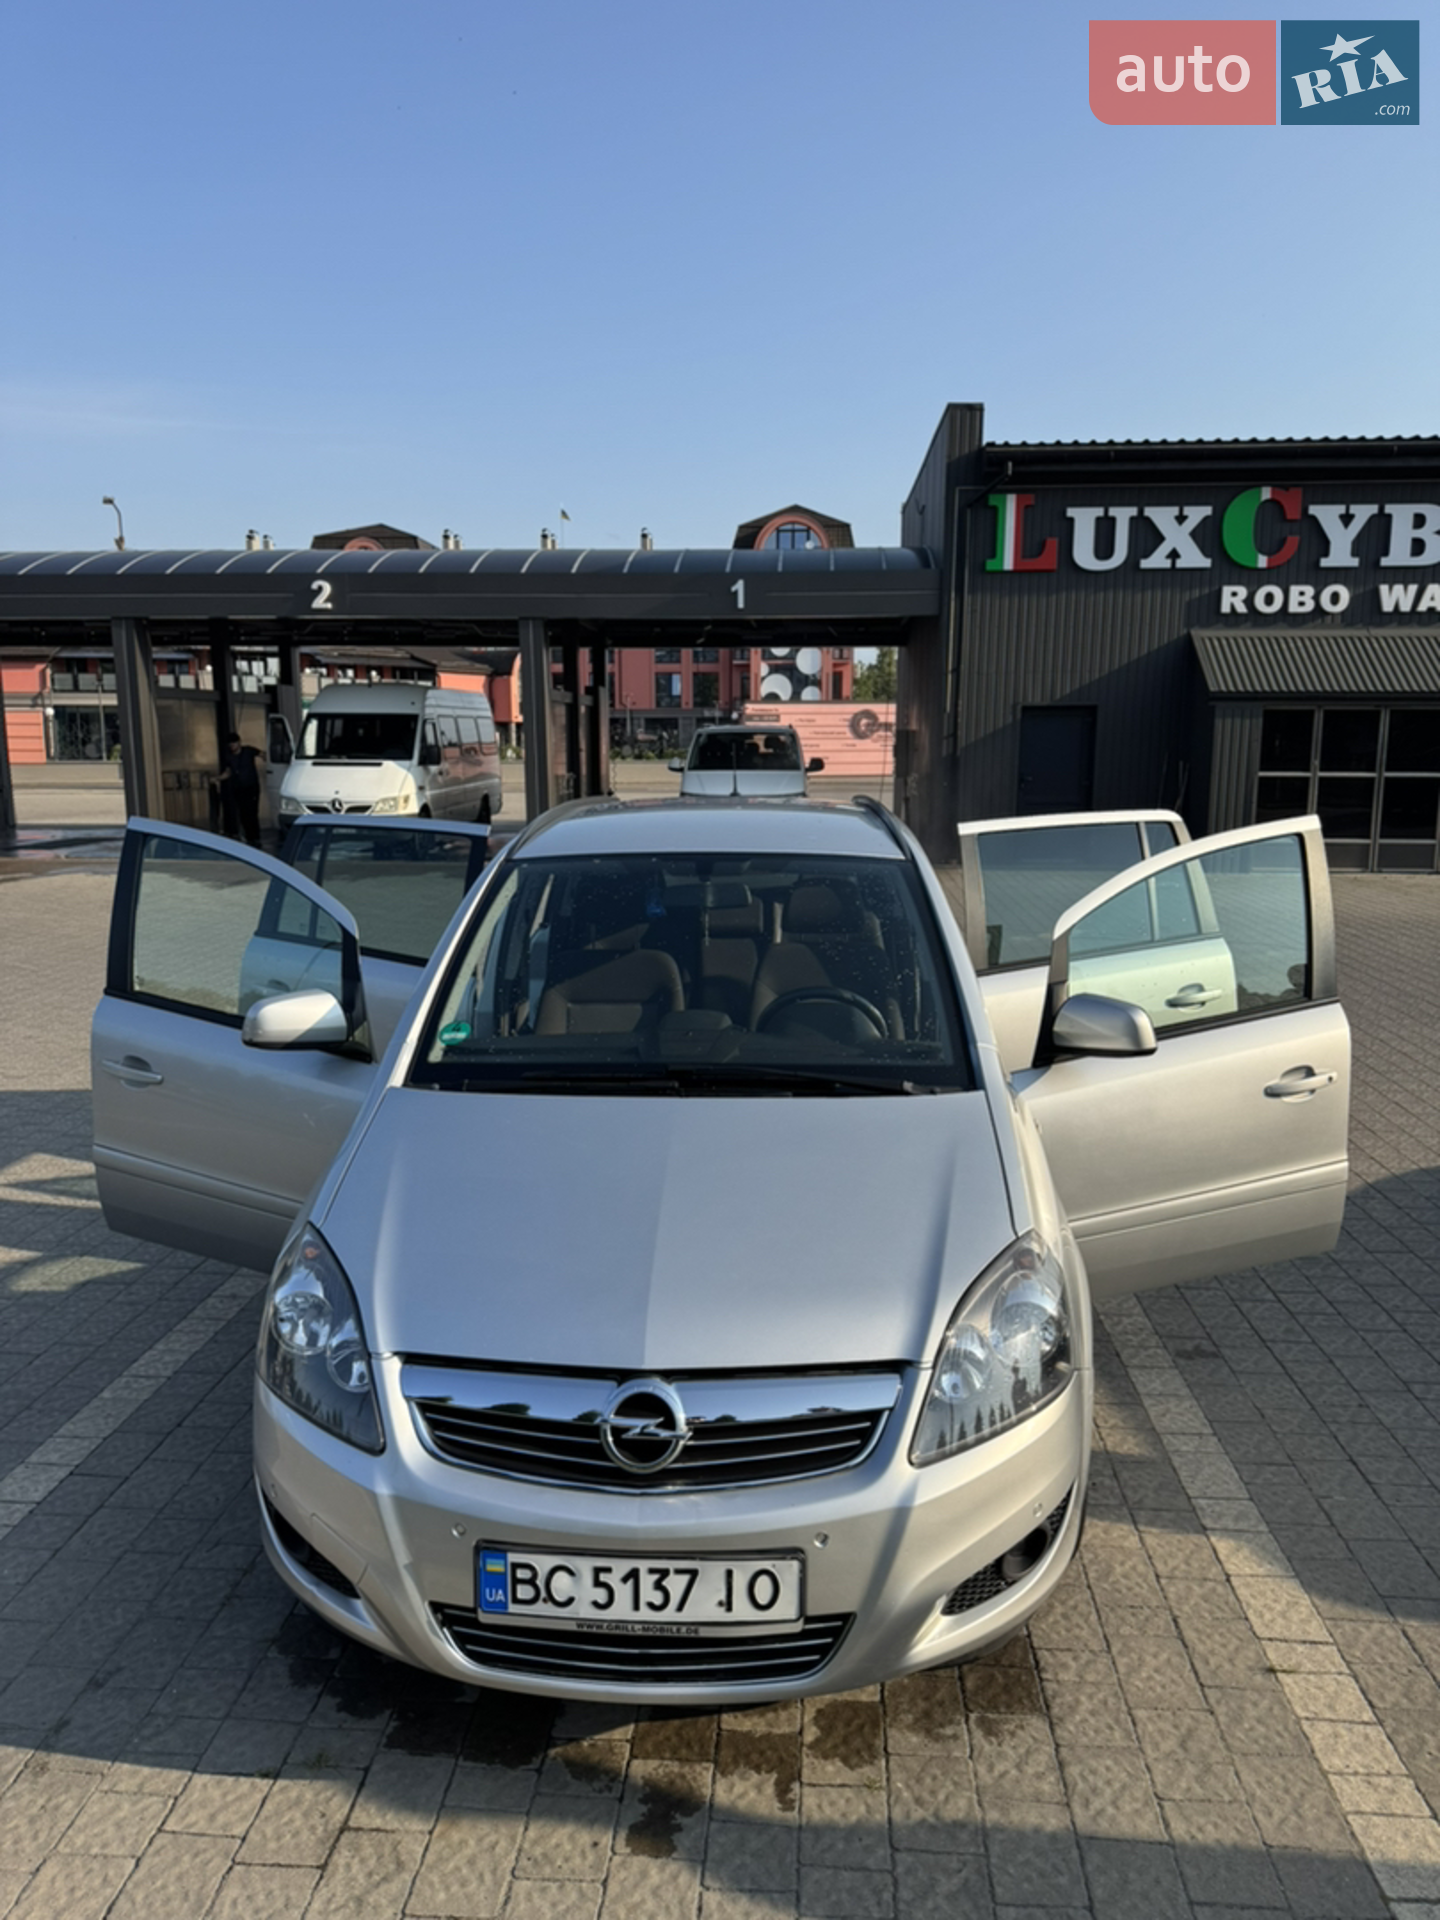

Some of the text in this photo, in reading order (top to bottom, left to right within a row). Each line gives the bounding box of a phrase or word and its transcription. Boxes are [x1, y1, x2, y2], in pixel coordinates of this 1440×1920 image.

[311, 580, 333, 609] 2
[730, 579, 745, 609] 1
[1220, 585, 1350, 614] ROBO
[485, 1587, 506, 1603] UA
[510, 1561, 780, 1613] BC 5137 IO
[575, 1621, 700, 1635] WWW.GRILL-MOBILE.DE
